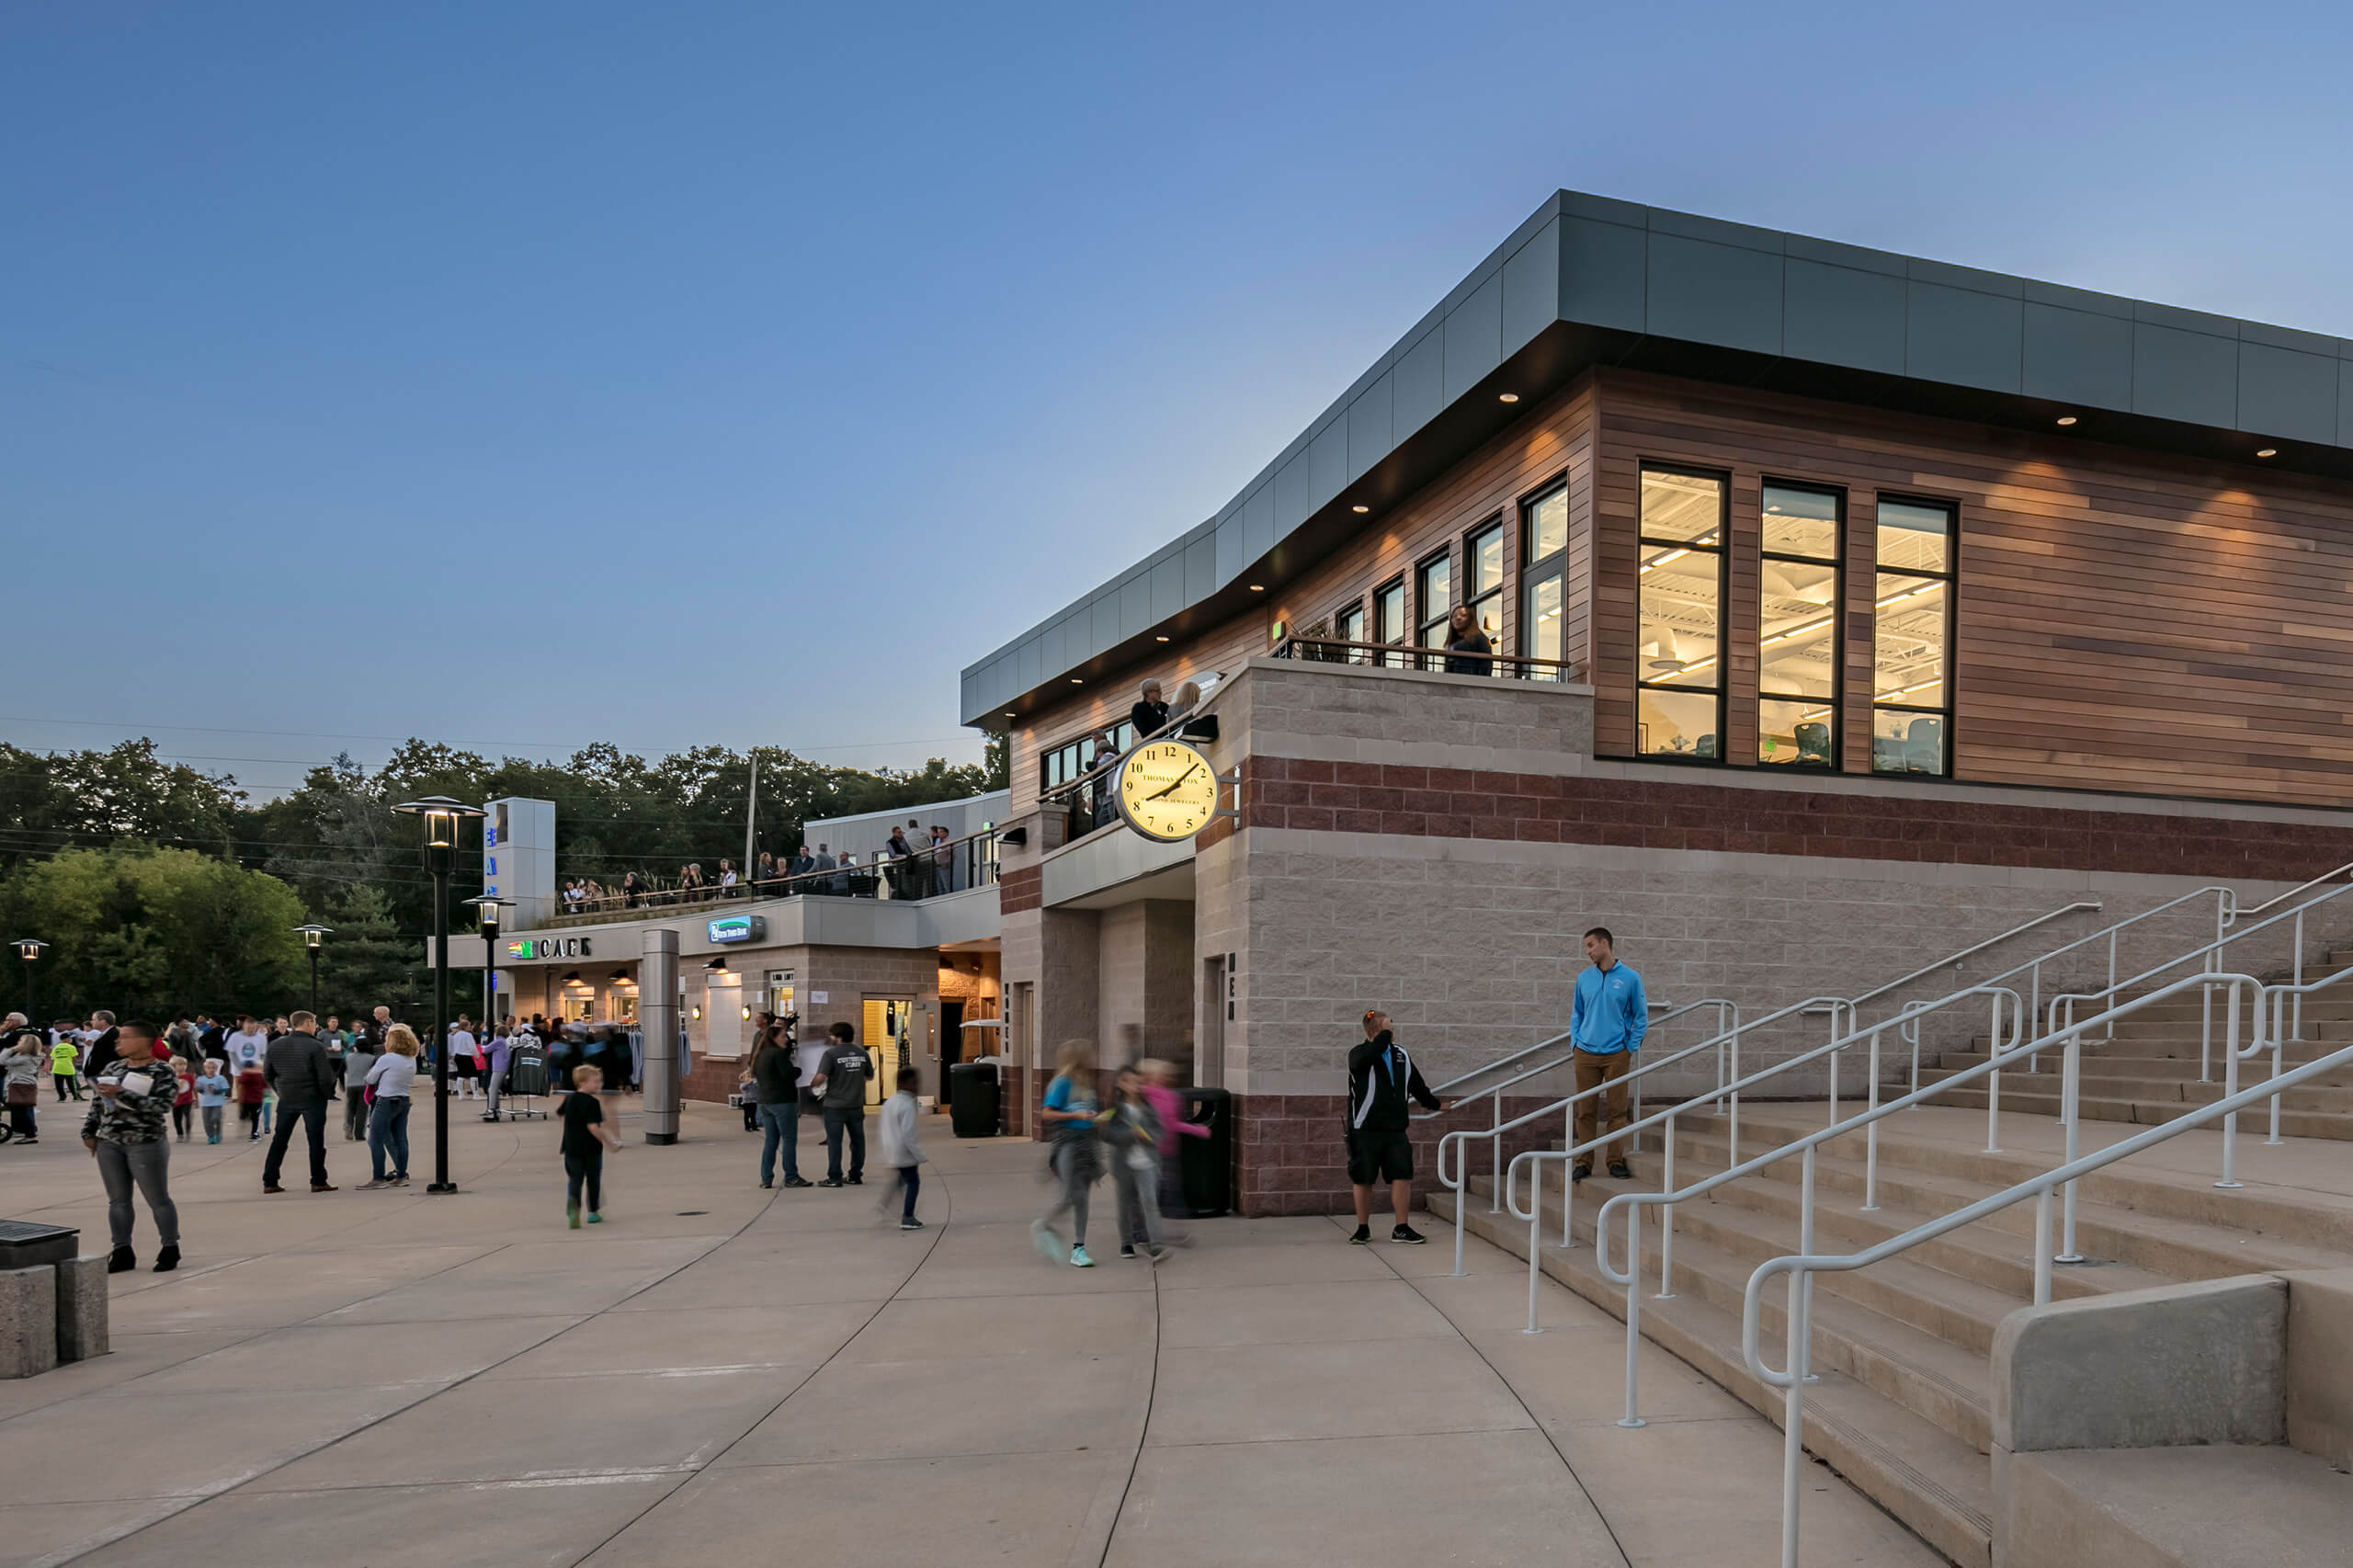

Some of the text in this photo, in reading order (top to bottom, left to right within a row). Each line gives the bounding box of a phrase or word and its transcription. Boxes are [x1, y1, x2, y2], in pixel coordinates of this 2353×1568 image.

[1146, 750, 1155, 761] 11
[1164, 746, 1176, 757] 12
[1187, 754, 1191, 764] 1
[1131, 763, 1143, 773] 10
[1200, 768, 1206, 778] 2
[1142, 774, 1174, 783] THOMAS
[1126, 781, 1133, 791] 9
[1206, 788, 1213, 798] 3
[1133, 801, 1141, 812] 8
[1199, 806, 1206, 816] 4
[1148, 816, 1154, 826] 7
[1186, 819, 1192, 829] 5
[1167, 823, 1174, 833] 6
[540, 937, 592, 958] CAFE
